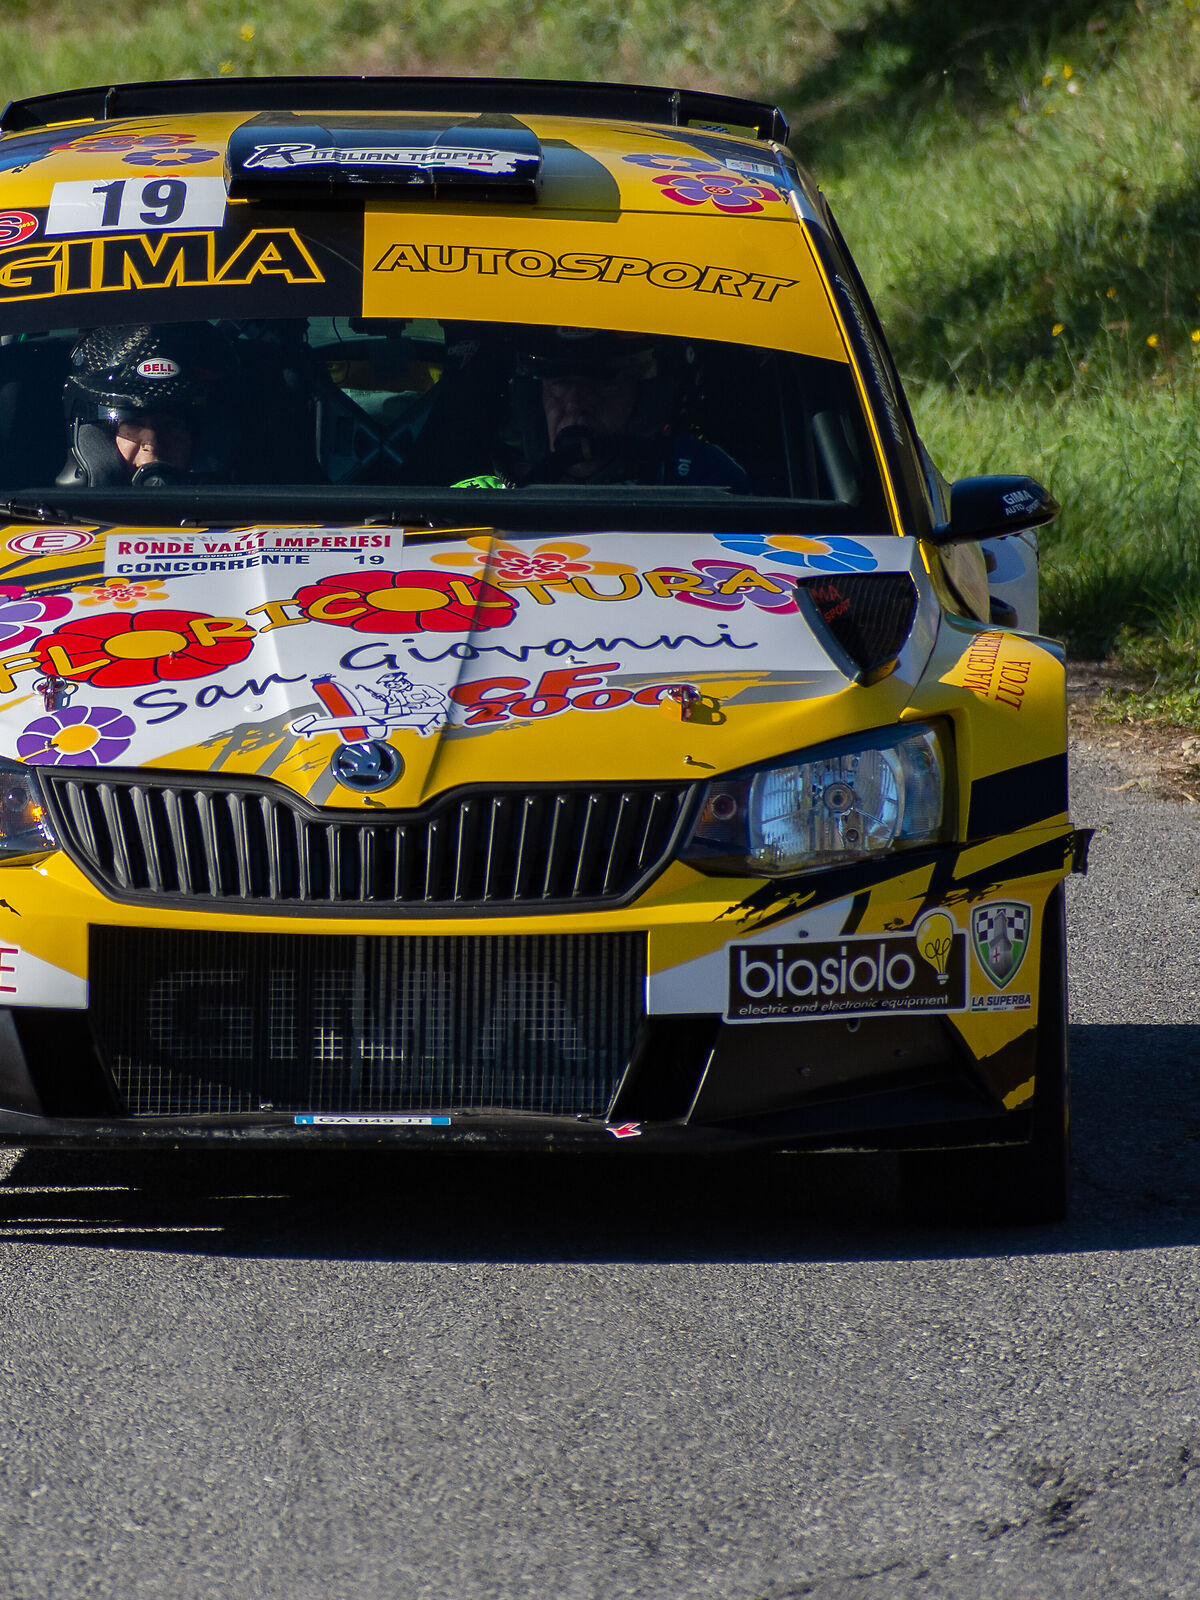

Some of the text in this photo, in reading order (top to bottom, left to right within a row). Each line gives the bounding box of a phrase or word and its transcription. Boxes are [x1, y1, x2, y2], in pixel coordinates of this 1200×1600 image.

[311, 150, 399, 161] ITALIAN
[408, 151, 499, 161] TROPHY
[93, 178, 188, 227] 19
[373, 243, 800, 302] AUTOSPORT
[143, 363, 175, 372] BELL
[1002, 489, 1034, 505] GIMA
[1005, 503, 1025, 516] AUTO
[33, 535, 68, 549] E
[117, 541, 194, 555] RONDE
[204, 538, 265, 553] VALLI
[275, 535, 391, 548] IMPERIESI
[116, 554, 385, 574] CONCORRENTE 19
[133, 623, 759, 725] San Giovanni
[995, 660, 1032, 711] LUCIA
[740, 943, 915, 998] biasiolo
[739, 994, 949, 1015] electric and electronic equipment
[971, 994, 1031, 1007] LA SUPERBA
